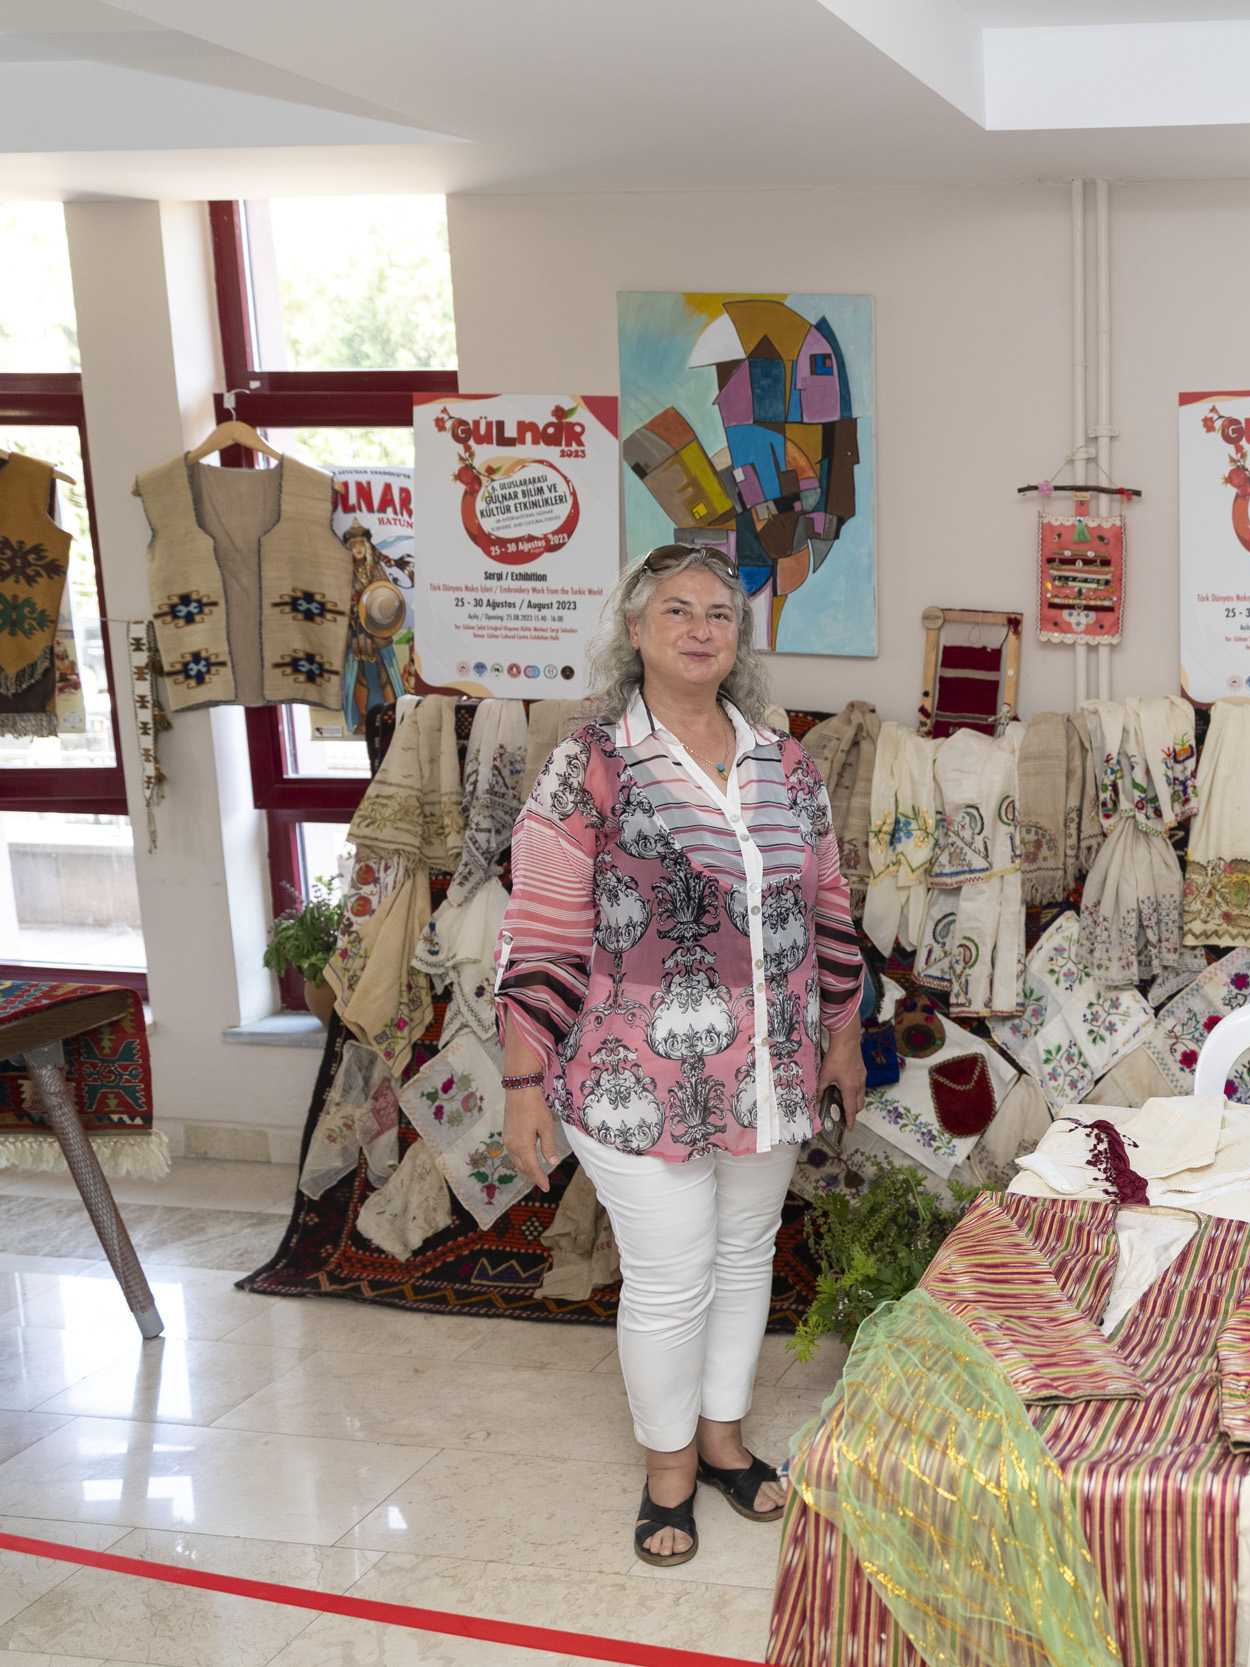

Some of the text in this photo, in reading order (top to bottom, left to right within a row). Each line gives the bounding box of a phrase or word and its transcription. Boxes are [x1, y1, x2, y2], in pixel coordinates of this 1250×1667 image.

[559, 449, 586, 458] 2023
[499, 474, 548, 491] ULUSLARARASI
[484, 483, 558, 506] GÜLNAR BİLİM VE
[480, 491, 568, 519] KÜLTÜR ETKİNLİKLERİ
[377, 517, 414, 529] HATUN
[490, 546, 500, 556] 25
[506, 542, 516, 552] 30
[518, 540, 546, 552] Ağustos
[550, 534, 568, 545] 2023
[484, 571, 503, 582] Sergi
[511, 572, 547, 582] Exhibition
[429, 583, 441, 591] Türk
[442, 584, 463, 594] Dünyası
[464, 584, 479, 594] Nakış
[500, 585, 530, 595] Embroidery
[531, 586, 544, 594] Work
[546, 586, 559, 594] from
[587, 588, 603, 596] World
[455, 598, 465, 607] 25
[473, 598, 483, 608] 30
[486, 599, 516, 610] Ağustos
[527, 600, 553, 612] August
[556, 600, 577, 610] 2023
[1197, 593, 1209, 602] Türk
[1212, 593, 1234, 604] Dünyası
[1225, 608, 1236, 618] 25
